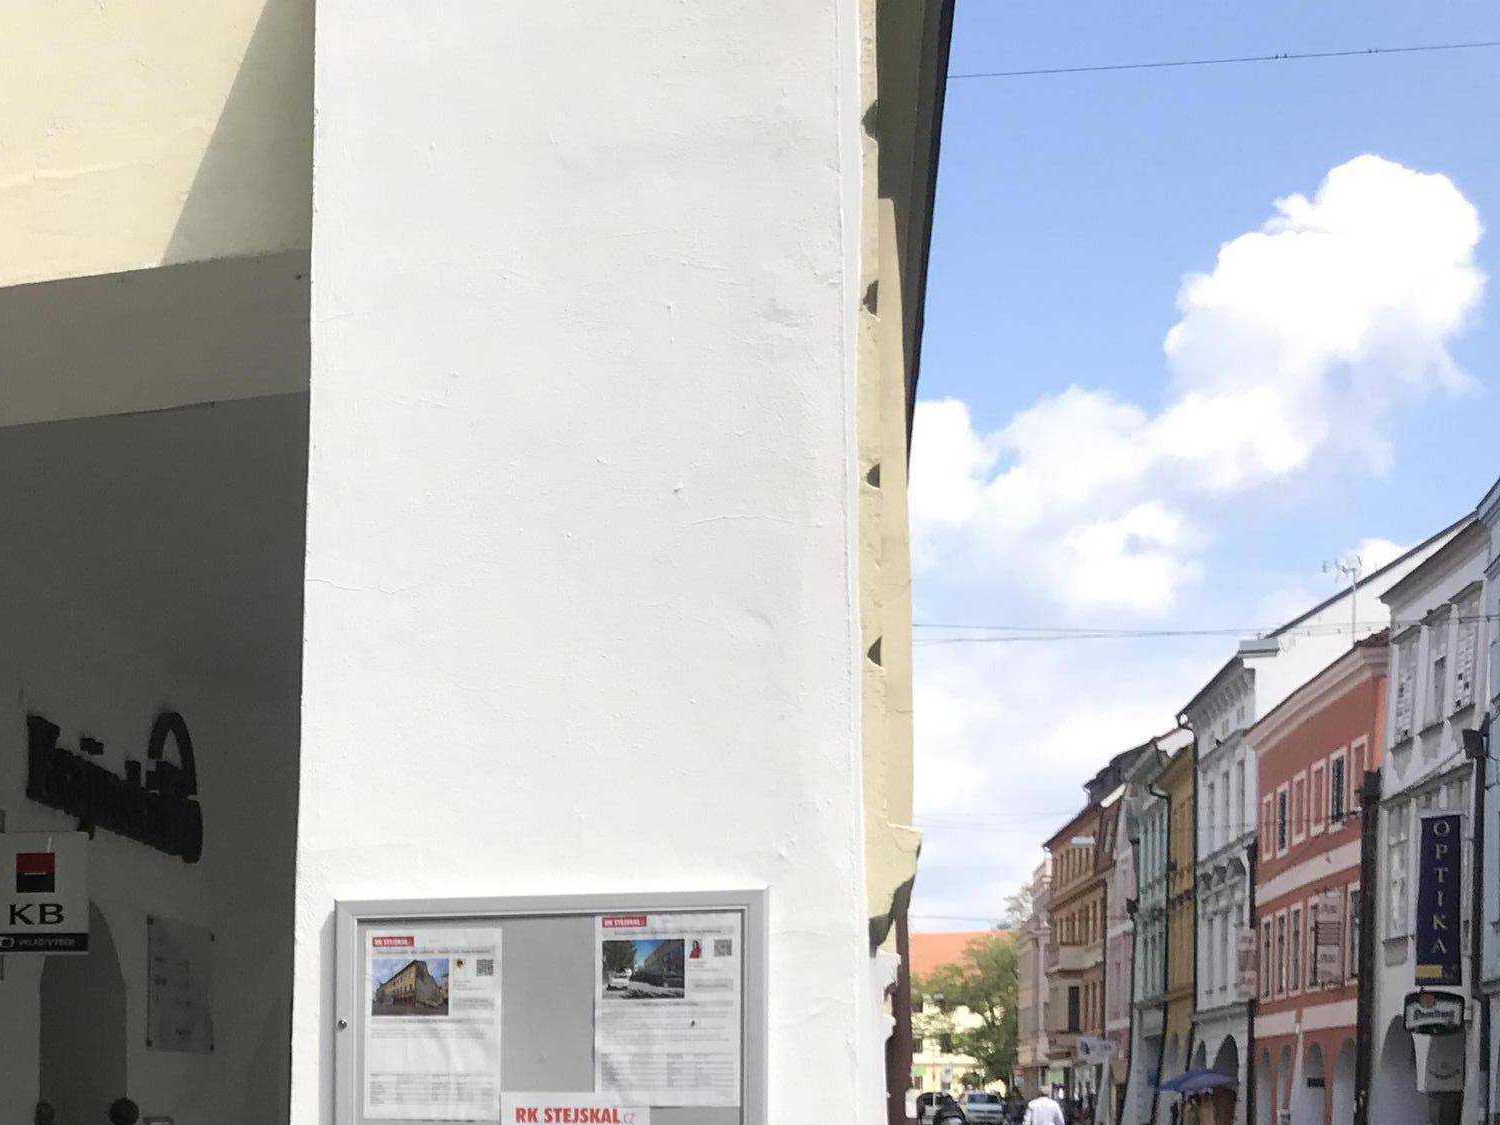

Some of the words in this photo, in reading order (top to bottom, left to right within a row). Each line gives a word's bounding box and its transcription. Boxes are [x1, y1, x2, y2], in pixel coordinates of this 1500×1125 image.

[1431, 820, 1451, 953] OPTIKA
[9, 903, 64, 925] KB
[515, 1107, 538, 1123] RK
